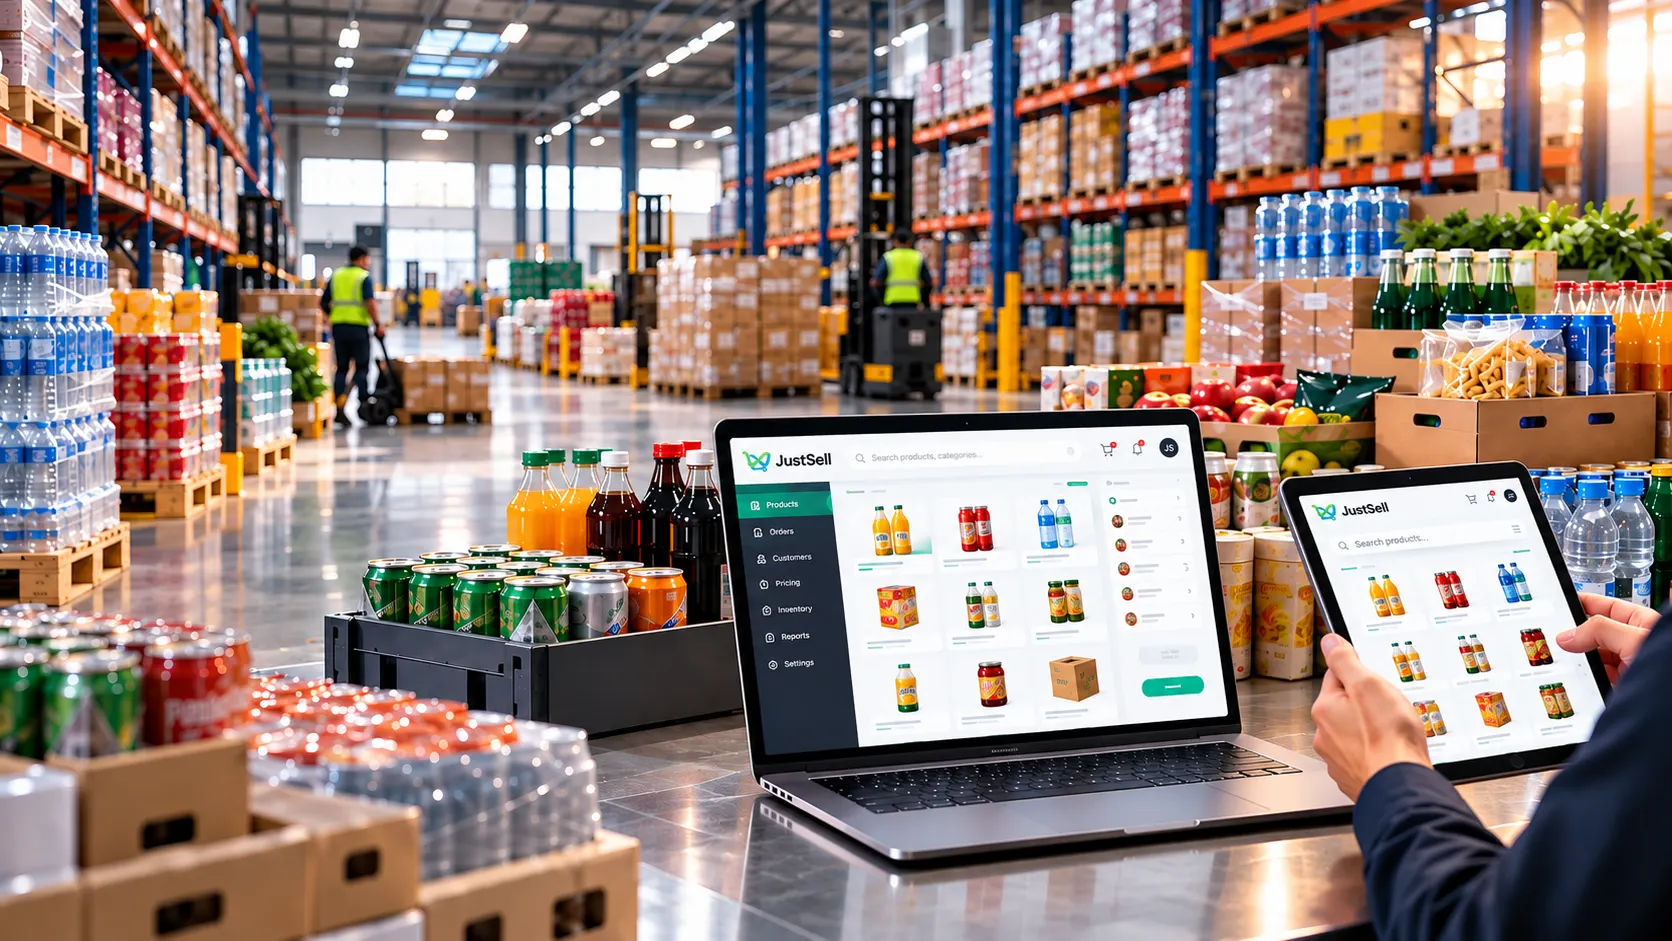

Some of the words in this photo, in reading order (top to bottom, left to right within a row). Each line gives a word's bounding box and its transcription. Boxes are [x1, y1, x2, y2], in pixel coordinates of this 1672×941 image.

[1163, 444, 1175, 452] JS
[775, 453, 832, 467] JustSell
[871, 453, 899, 462] Search
[900, 453, 937, 463] products,
[766, 501, 799, 509] Products
[1341, 501, 1390, 517] JustSell
[769, 528, 795, 536] Orders
[1354, 538, 1385, 549] Search
[772, 554, 812, 562] Customers
[775, 579, 801, 588] Pricing
[781, 633, 810, 642] Reports
[784, 660, 815, 668] Settings
